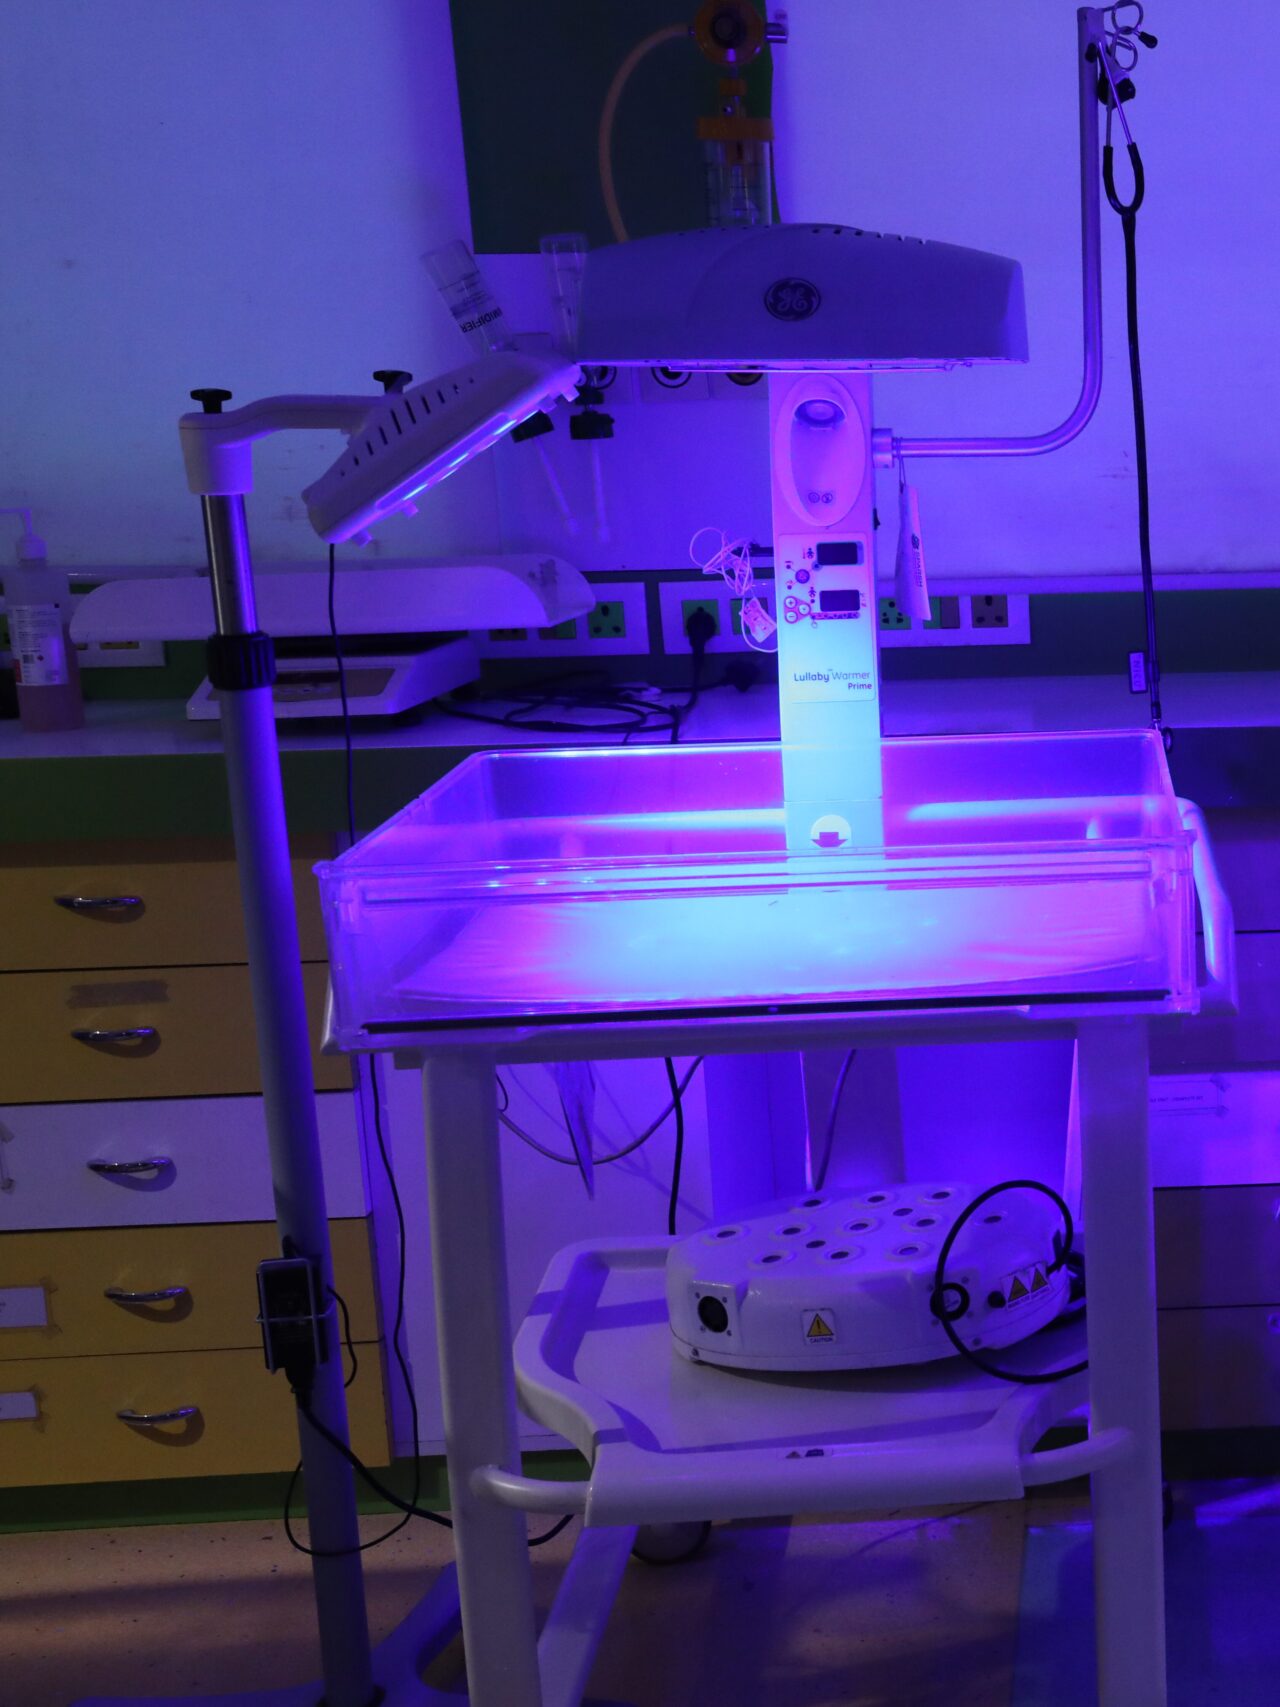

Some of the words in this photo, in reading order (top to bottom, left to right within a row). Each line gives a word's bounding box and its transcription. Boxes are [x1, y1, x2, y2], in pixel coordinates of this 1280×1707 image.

[794, 672, 830, 682] Lullaby
[831, 671, 870, 681] Warmer
[848, 682, 873, 690] Prime
